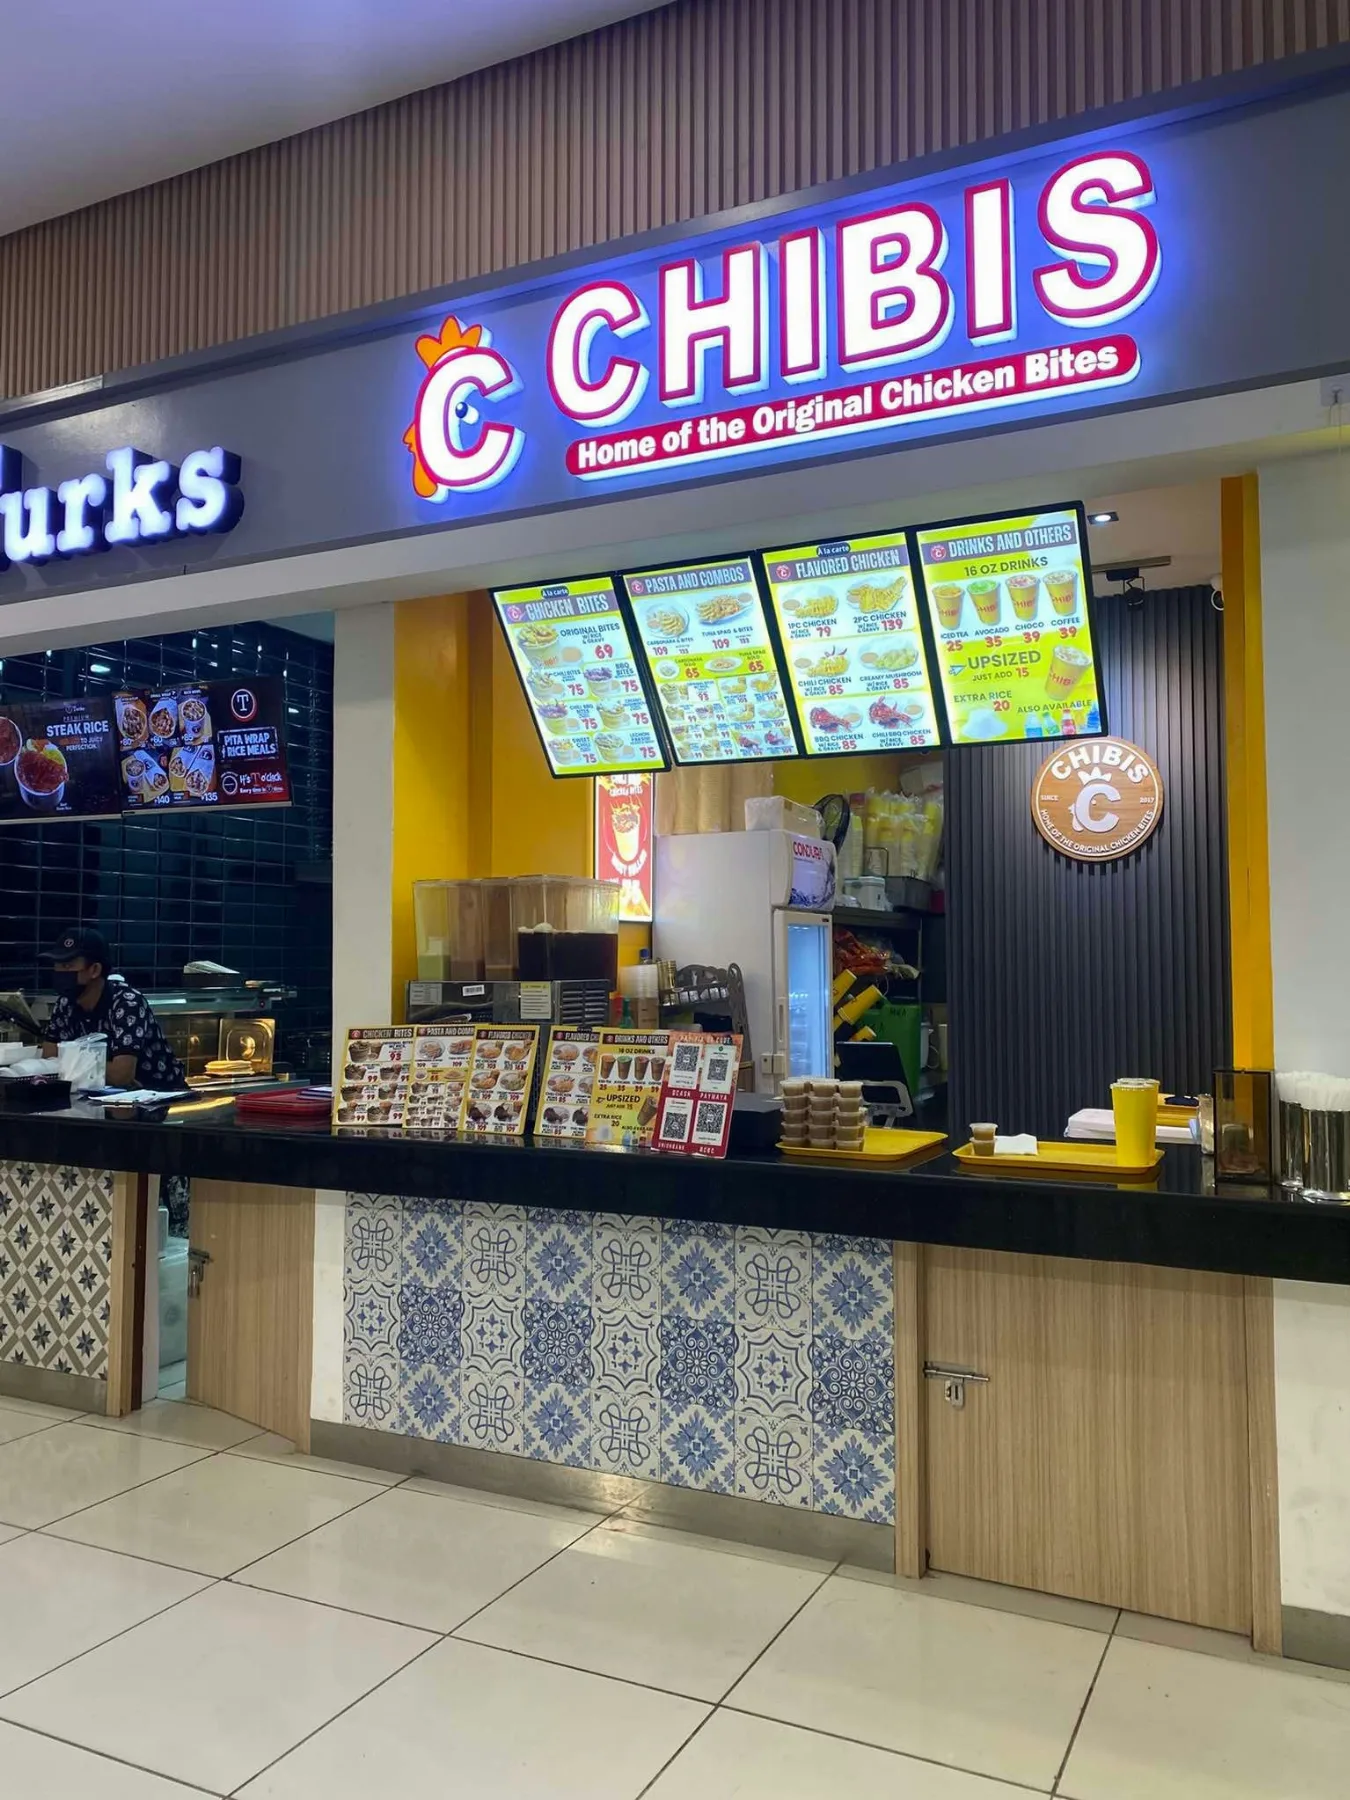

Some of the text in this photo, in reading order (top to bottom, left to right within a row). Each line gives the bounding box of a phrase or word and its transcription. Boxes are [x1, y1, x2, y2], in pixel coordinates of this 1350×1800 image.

[546, 149, 1161, 424] CHIBIS
[578, 345, 1119, 469] Home of the Original Chicken Bites
[0, 445, 230, 562] urks
[948, 525, 1072, 557] DRINKS AND OTHERS
[832, 546, 849, 554] carte
[796, 549, 900, 578] FLAVORED CHICKEN
[965, 557, 1048, 577] 16 OZ DRINKS
[645, 566, 744, 593] PASTA AND COMBOS
[526, 594, 609, 621] CHICKEN BITES
[803, 618, 837, 628] CHICKEN
[853, 611, 907, 624] 2PC CHICKEN
[1051, 617, 1080, 627] COFFEE
[560, 623, 620, 637] ORIGINAL BITES
[882, 619, 903, 631] 139
[1015, 622, 1045, 631] CHOCO
[816, 626, 831, 638] 79
[975, 627, 1010, 636] AVOCADO
[1059, 627, 1077, 639] 39
[712, 639, 730, 649] 109
[985, 636, 1003, 648] 35
[1023, 632, 1041, 644] 39
[595, 644, 613, 659] 69
[653, 647, 668, 656] 109
[946, 641, 964, 652] 25
[748, 661, 764, 672] 65
[968, 651, 1041, 670] UPSIZED
[685, 668, 700, 678] 65
[886, 671, 922, 679] MUSHROOM
[972, 668, 1030, 681] JUST ADD 15
[621, 680, 639, 692] 75
[798, 677, 852, 687] CHILI CHICKEN
[893, 678, 909, 689] 85
[568, 684, 585, 696] 75
[829, 685, 844, 695] 85
[954, 691, 1012, 703] EXTRA RICE
[994, 701, 1010, 712] 20
[1017, 700, 1092, 714] ALSO AVAILABLE
[582, 719, 598, 730] 75
[633, 713, 649, 725] 75
[47, 721, 109, 737] STEAK RICE
[224, 733, 270, 746] PITA WRAP
[842, 741, 857, 750] 85
[910, 736, 926, 746] 85
[227, 743, 276, 757] RICE MEALS
[640, 747, 656, 758] 75
[583, 754, 597, 763] 75
[1051, 745, 1149, 783] CHIBIS
[1040, 809, 1154, 853] HOME OF THE ORIGINAL CHICKEN BITES
[363, 1029, 412, 1039] CHICKEN BITES
[615, 1035, 668, 1044] DRINKS AND OTHERS
[606, 1094, 641, 1103] UPSIZED
